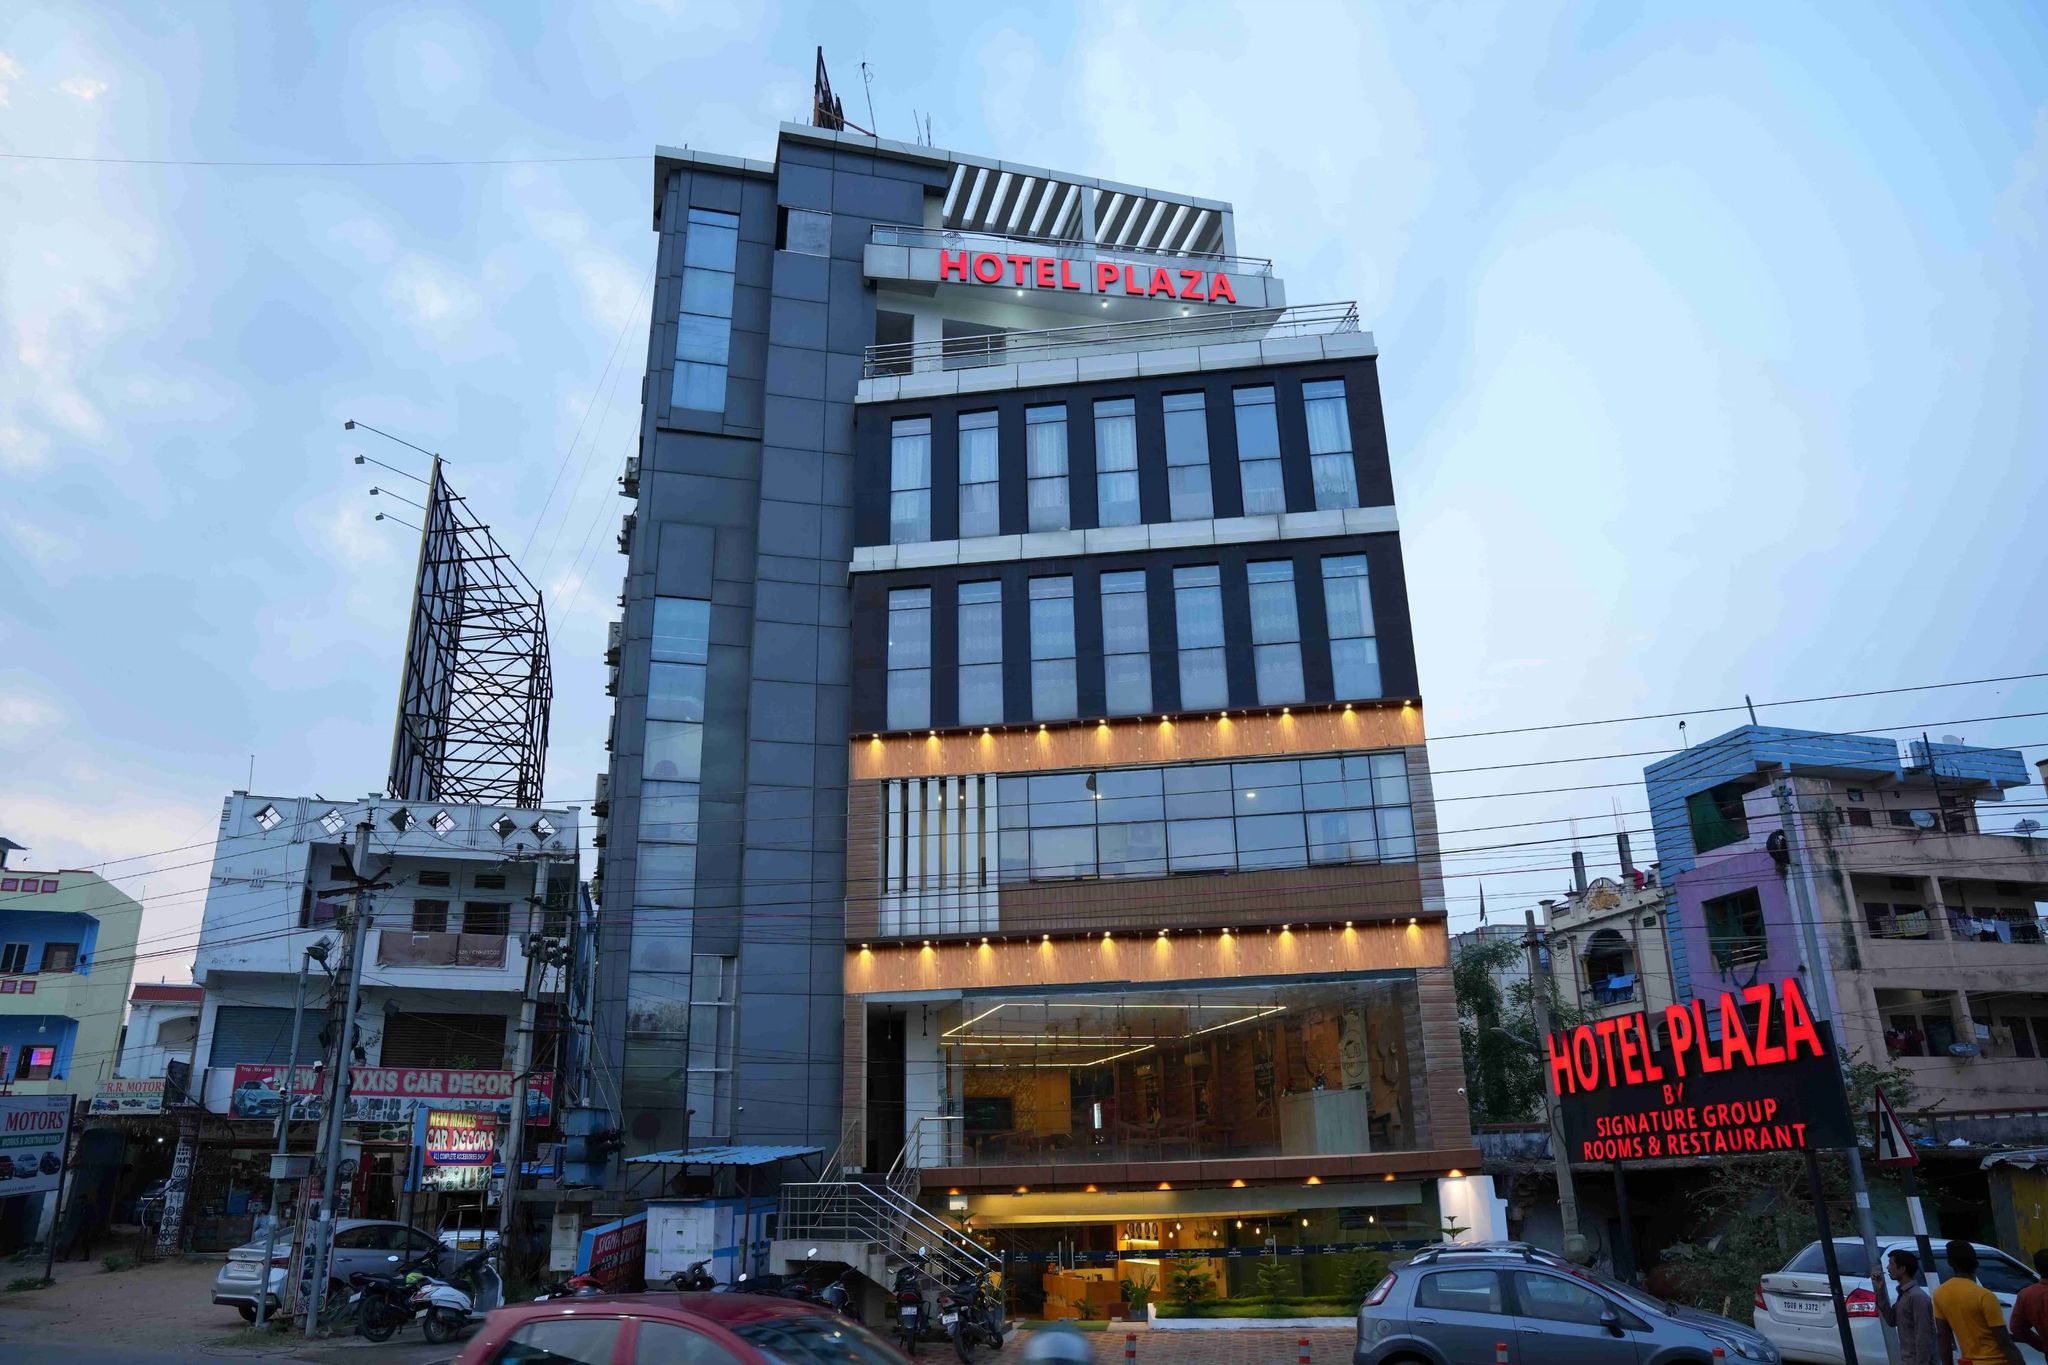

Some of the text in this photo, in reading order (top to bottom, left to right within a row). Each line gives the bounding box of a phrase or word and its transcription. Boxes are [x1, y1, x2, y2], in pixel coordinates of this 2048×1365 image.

[940, 249, 1237, 304] HOTEL PLAZA
[1547, 977, 1824, 1097] HOTEL PLAZA
[346, 1069, 398, 1093] XXIS
[403, 1071, 443, 1094] CAR
[1663, 1082, 1684, 1106] BY
[5, 1111, 65, 1131] MOTORS
[430, 1112, 449, 1127] NEW
[1596, 1098, 1777, 1137] SIGNATURE GROUP
[426, 1128, 495, 1151] CAR DECORS
[1584, 1123, 1806, 1160] ROOMS & RESTAURANT
